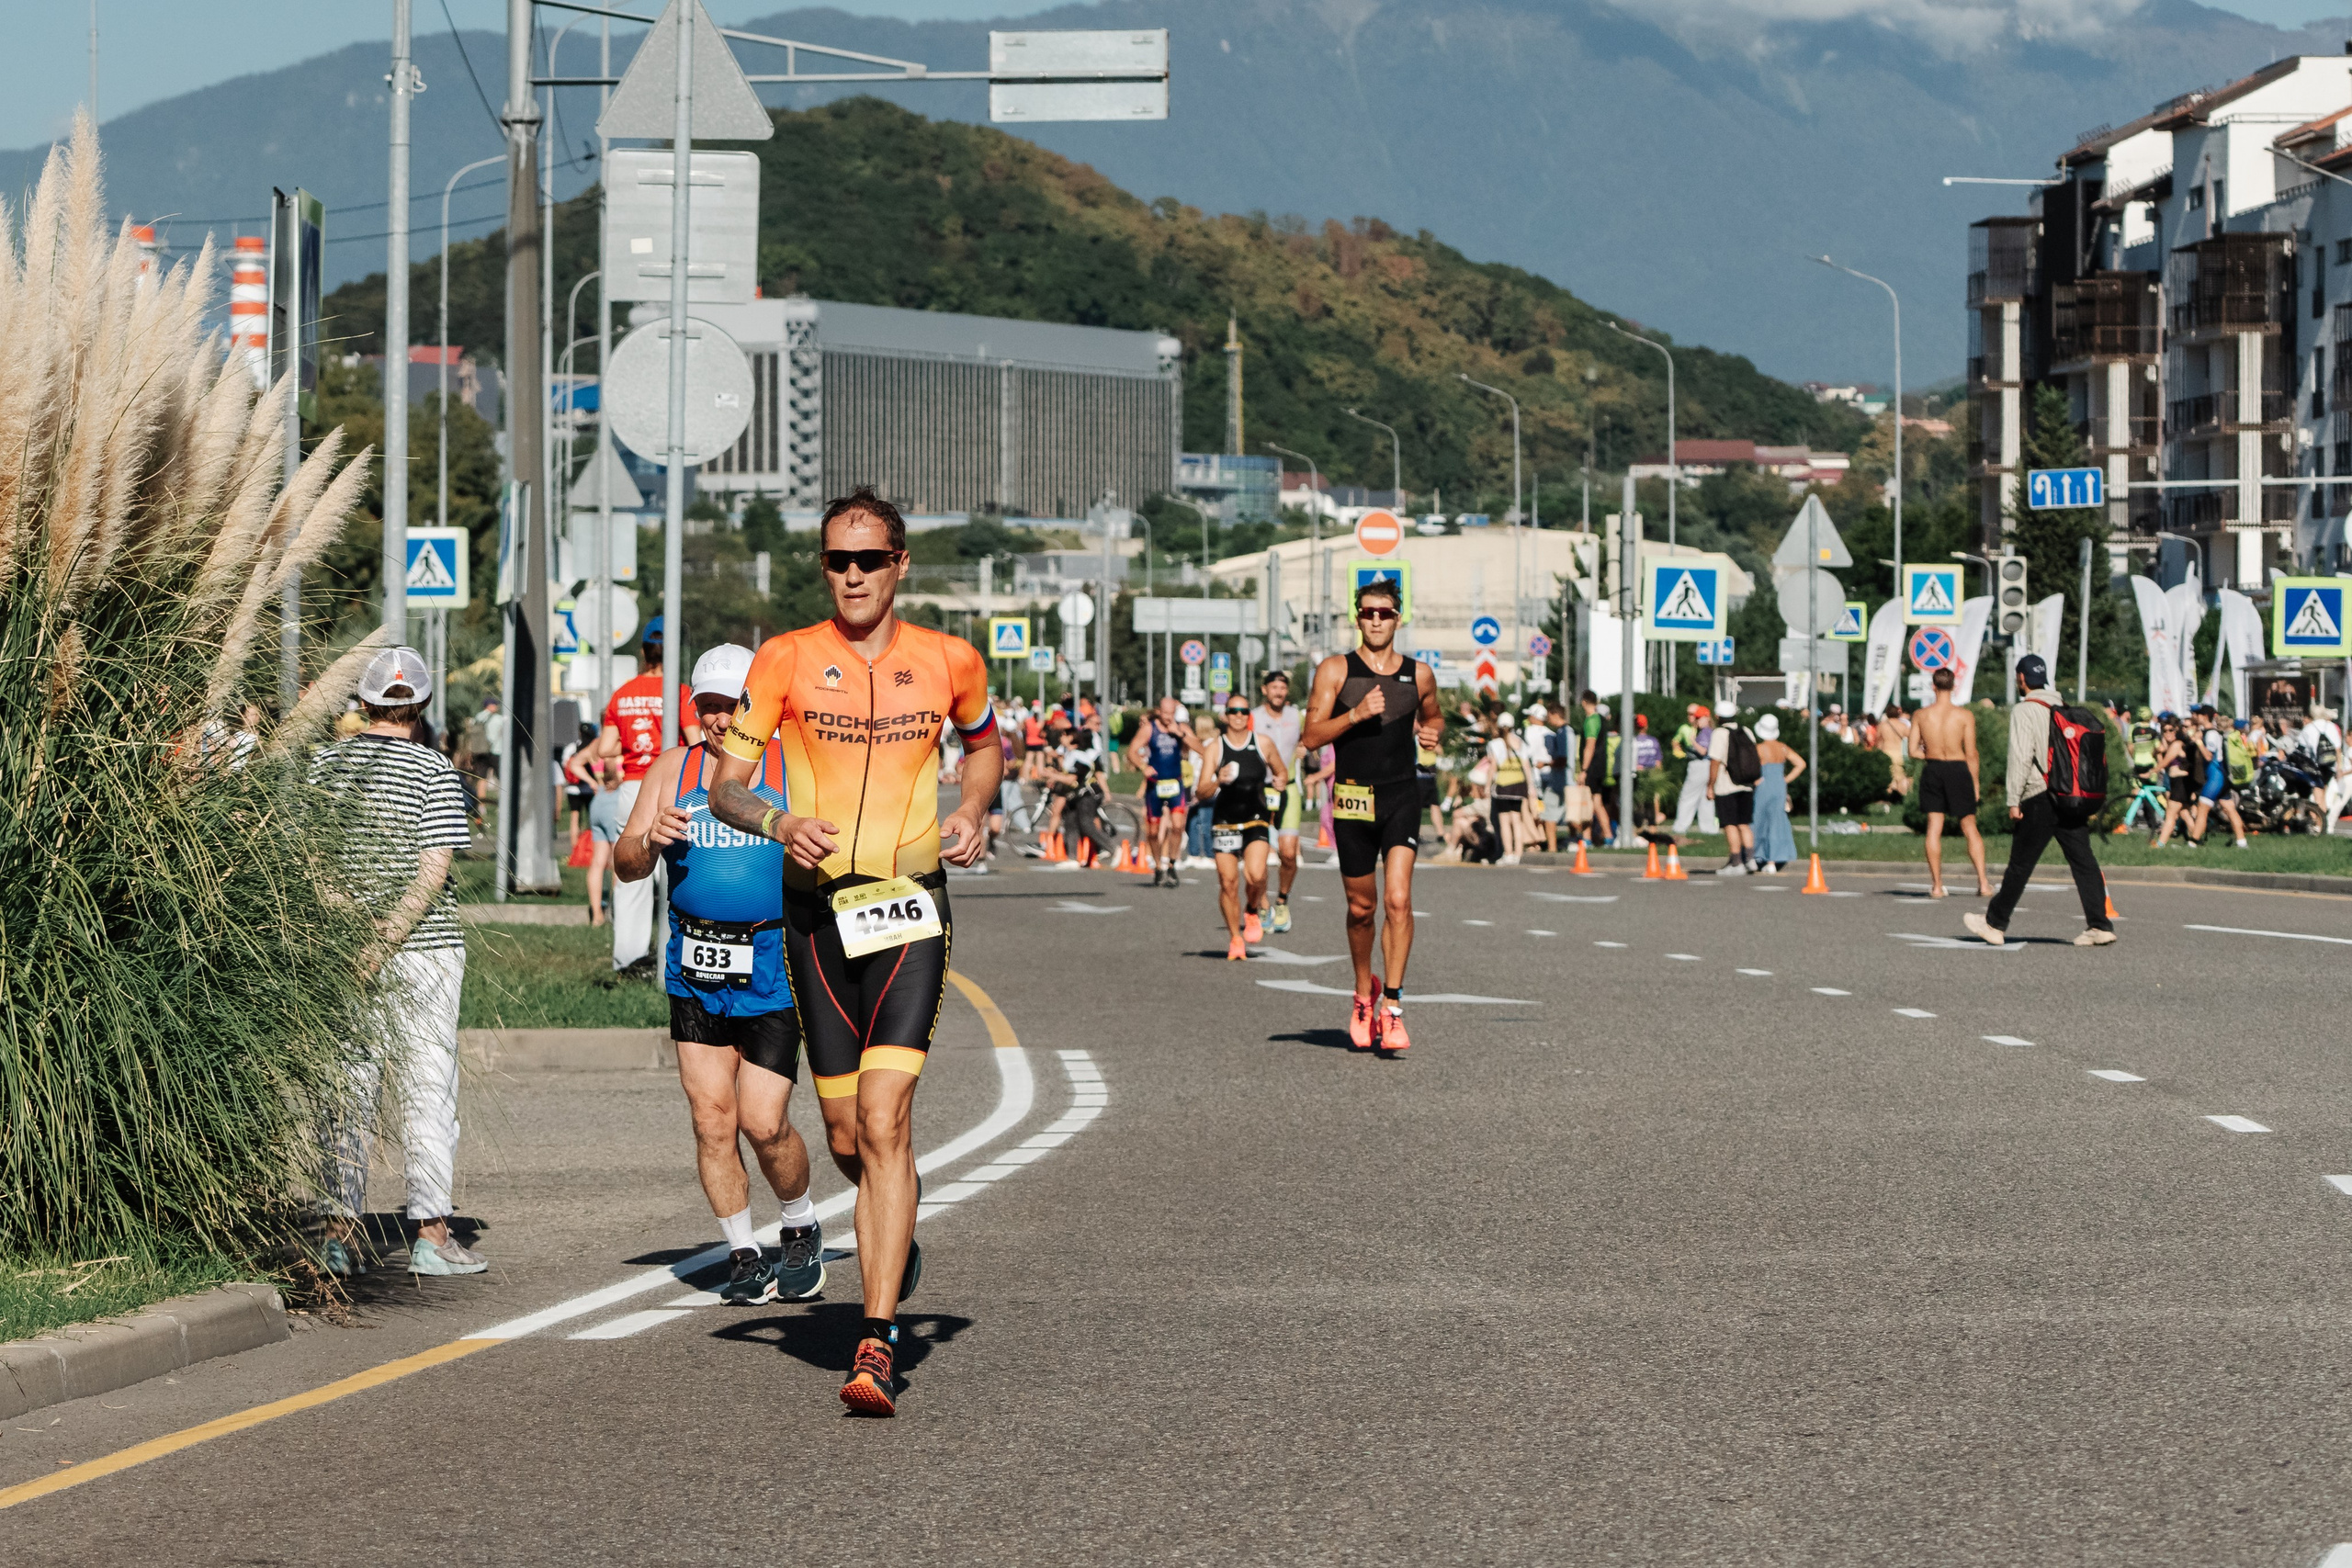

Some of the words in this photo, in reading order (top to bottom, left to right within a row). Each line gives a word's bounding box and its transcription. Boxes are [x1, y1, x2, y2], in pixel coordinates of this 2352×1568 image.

[703, 659, 731, 673] TYR
[815, 686, 849, 694] РОСНЕФТЬ
[804, 710, 943, 731] РОСНЕФТЬ
[814, 728, 930, 745] ТРИАТЛОН
[1337, 797, 1368, 812] 4071
[854, 898, 923, 935] 4246
[693, 944, 731, 969] 633
[695, 971, 726, 980] ВЯЧЕСЛАВ
